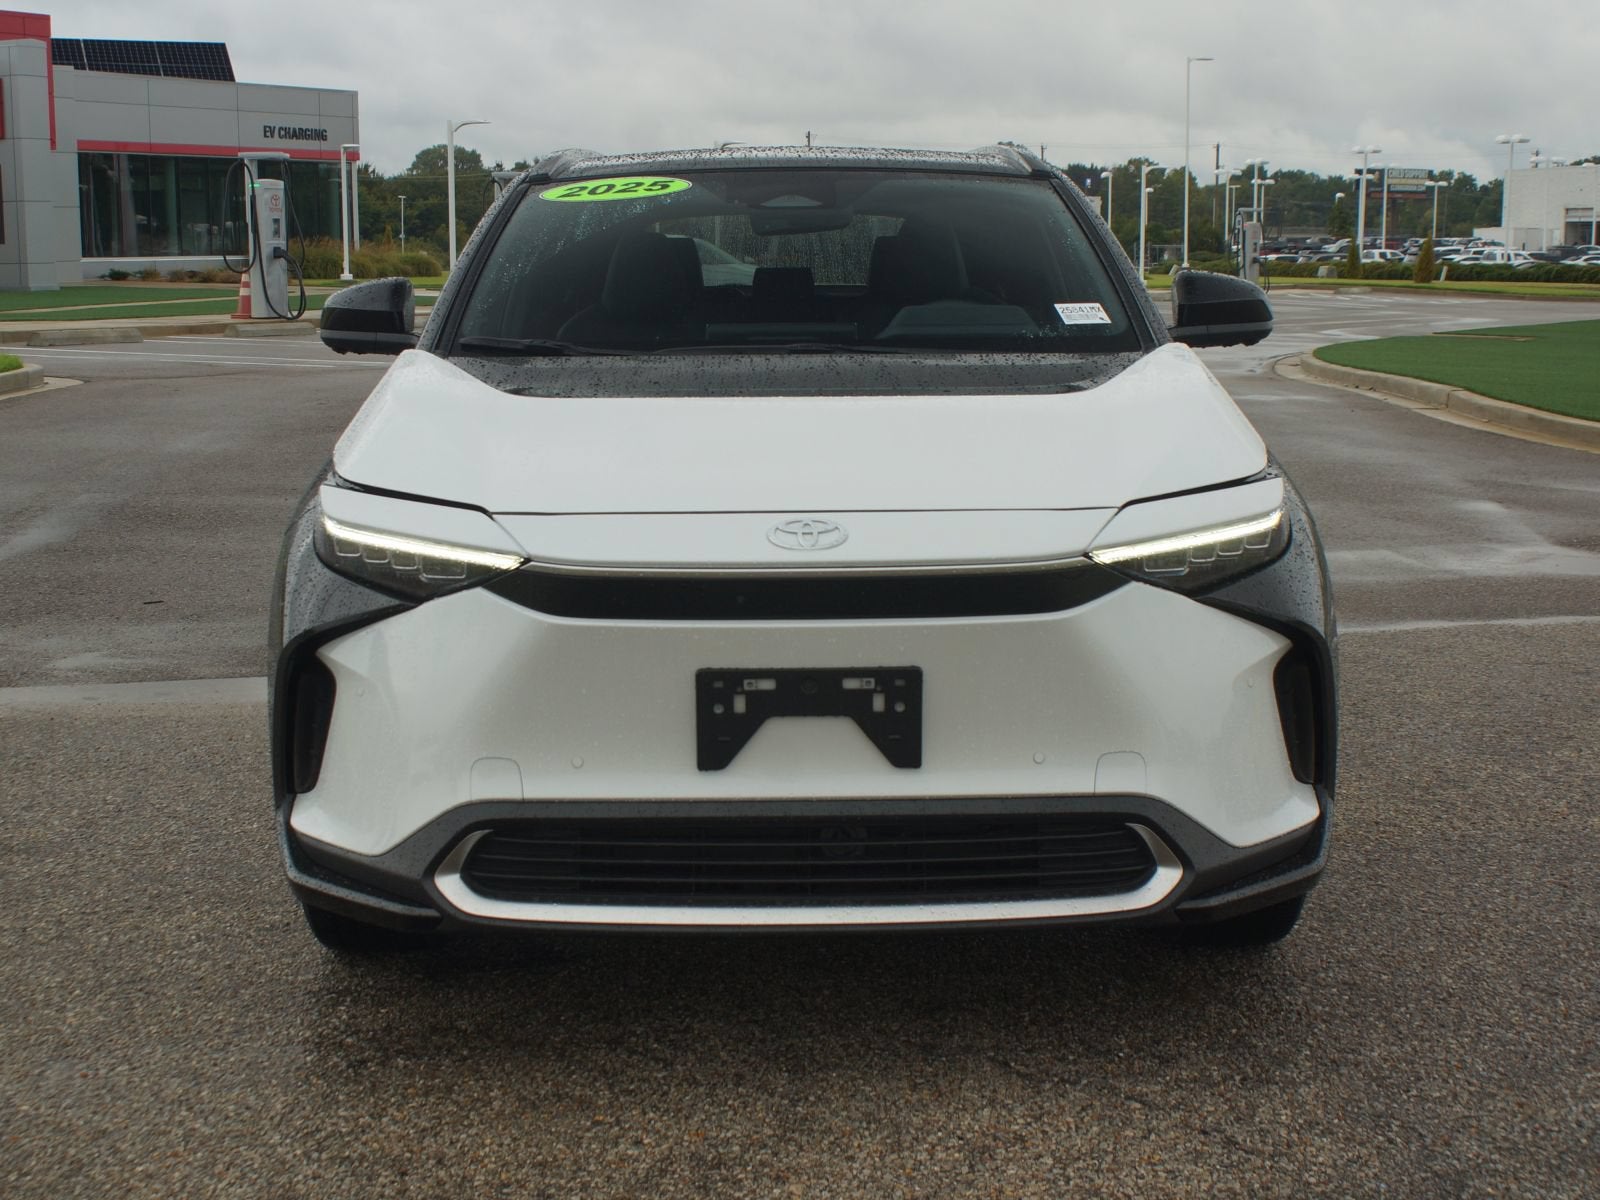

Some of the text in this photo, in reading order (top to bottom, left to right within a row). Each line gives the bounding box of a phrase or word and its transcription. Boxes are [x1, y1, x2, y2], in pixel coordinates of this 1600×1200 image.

[263, 125, 328, 141] EV CHARGING
[1404, 169, 1428, 179] SUPPORT
[556, 180, 675, 199] 2025
